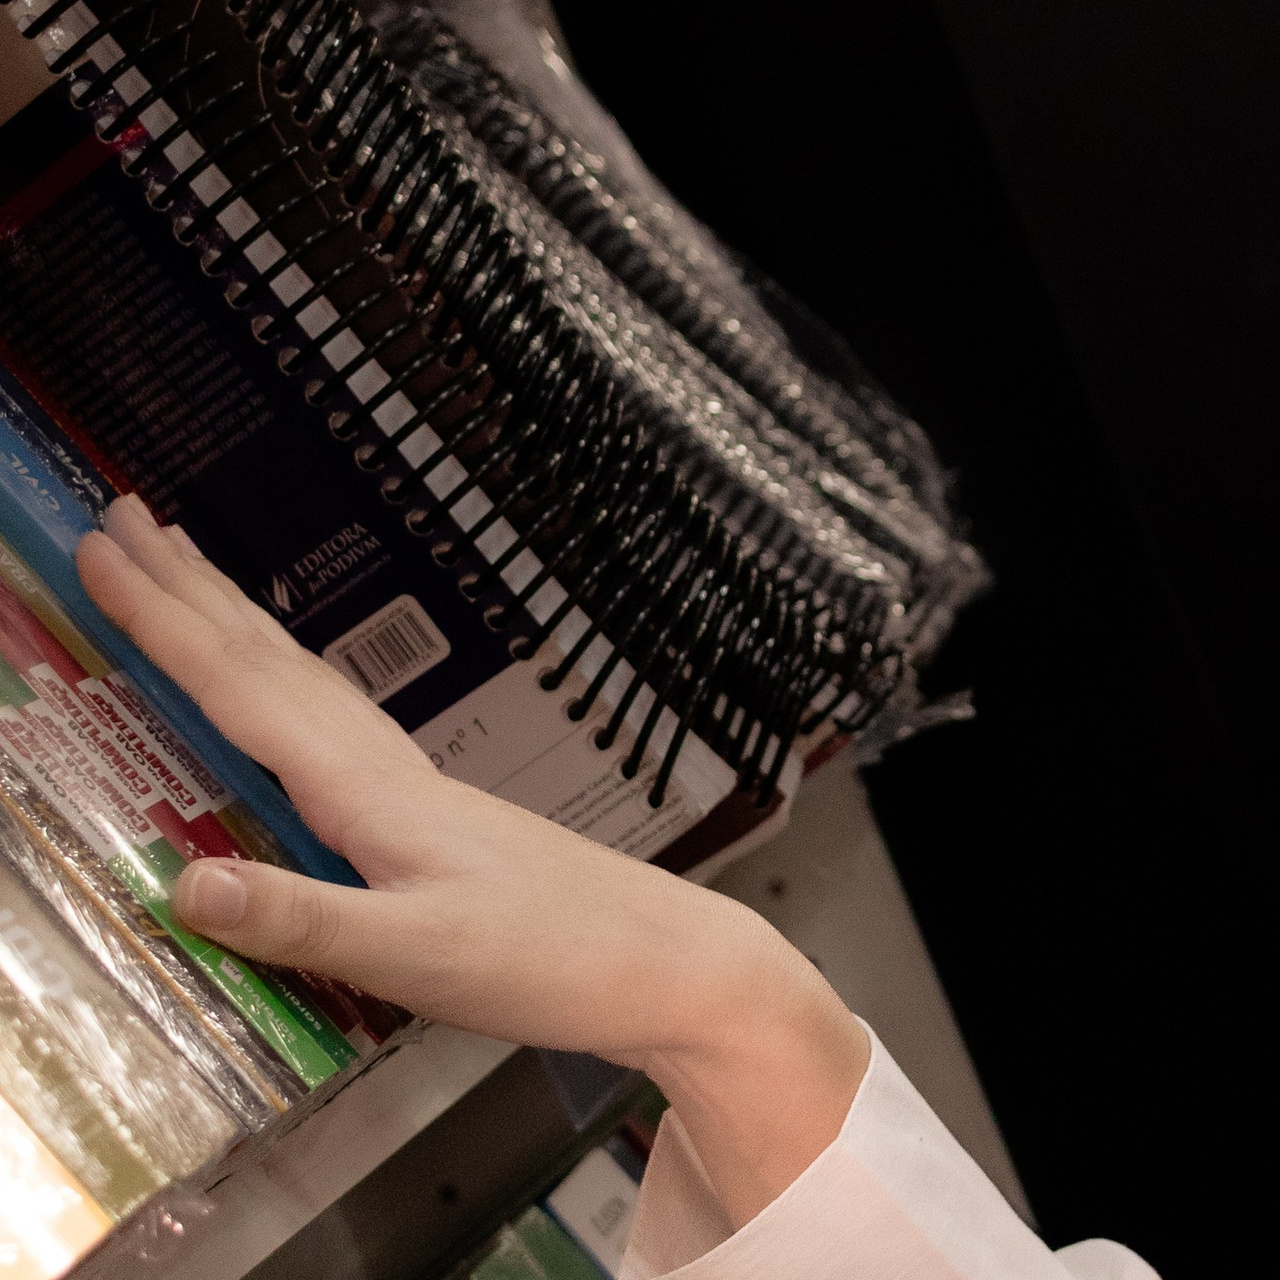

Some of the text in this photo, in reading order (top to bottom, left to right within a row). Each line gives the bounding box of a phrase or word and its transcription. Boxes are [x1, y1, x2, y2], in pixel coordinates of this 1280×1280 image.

[7, 450, 62, 513] CIVIL
[293, 519, 369, 578] EDITORA
[37, 674, 151, 797] COMPLETAÇO
[67, 716, 97, 754] OAB
[84, 688, 196, 808] COMPLETAÇO
[115, 730, 145, 767] OAB
[144, 721, 173, 757] OAB
[472, 716, 489, 735] 1
[160, 778, 185, 811] PASSE
[242, 981, 296, 1043] saraiva
